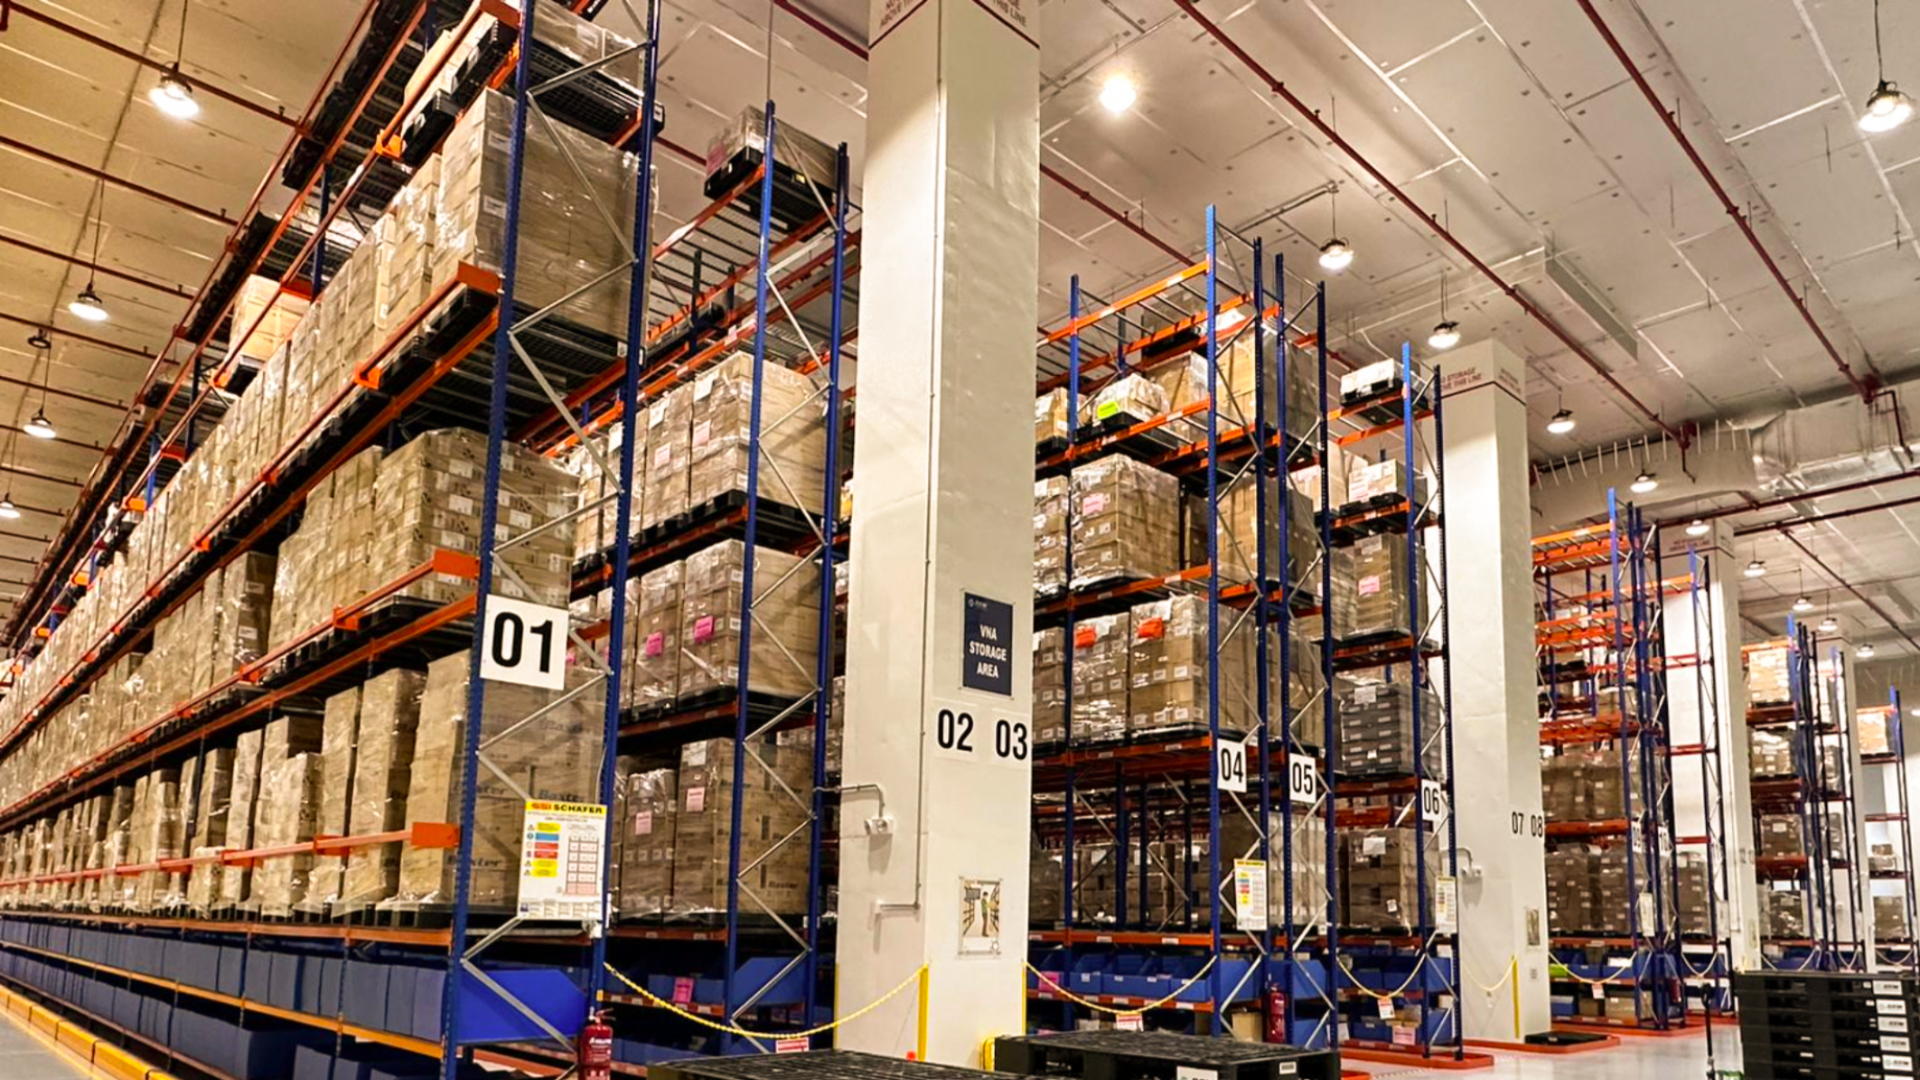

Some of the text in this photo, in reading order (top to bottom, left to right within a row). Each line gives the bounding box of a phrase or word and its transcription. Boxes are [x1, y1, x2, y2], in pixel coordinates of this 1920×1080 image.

[491, 611, 553, 674] 01
[980, 623, 998, 641] VNA
[969, 640, 1007, 662] STORAGE
[976, 661, 999, 678] AREA
[937, 709, 974, 752] 02
[996, 719, 1028, 760] 03
[1221, 748, 1244, 783] 04
[1292, 762, 1313, 795] 05
[1423, 786, 1440, 816] 06
[1511, 811, 1524, 835] 07
[1530, 815, 1543, 838] 08
